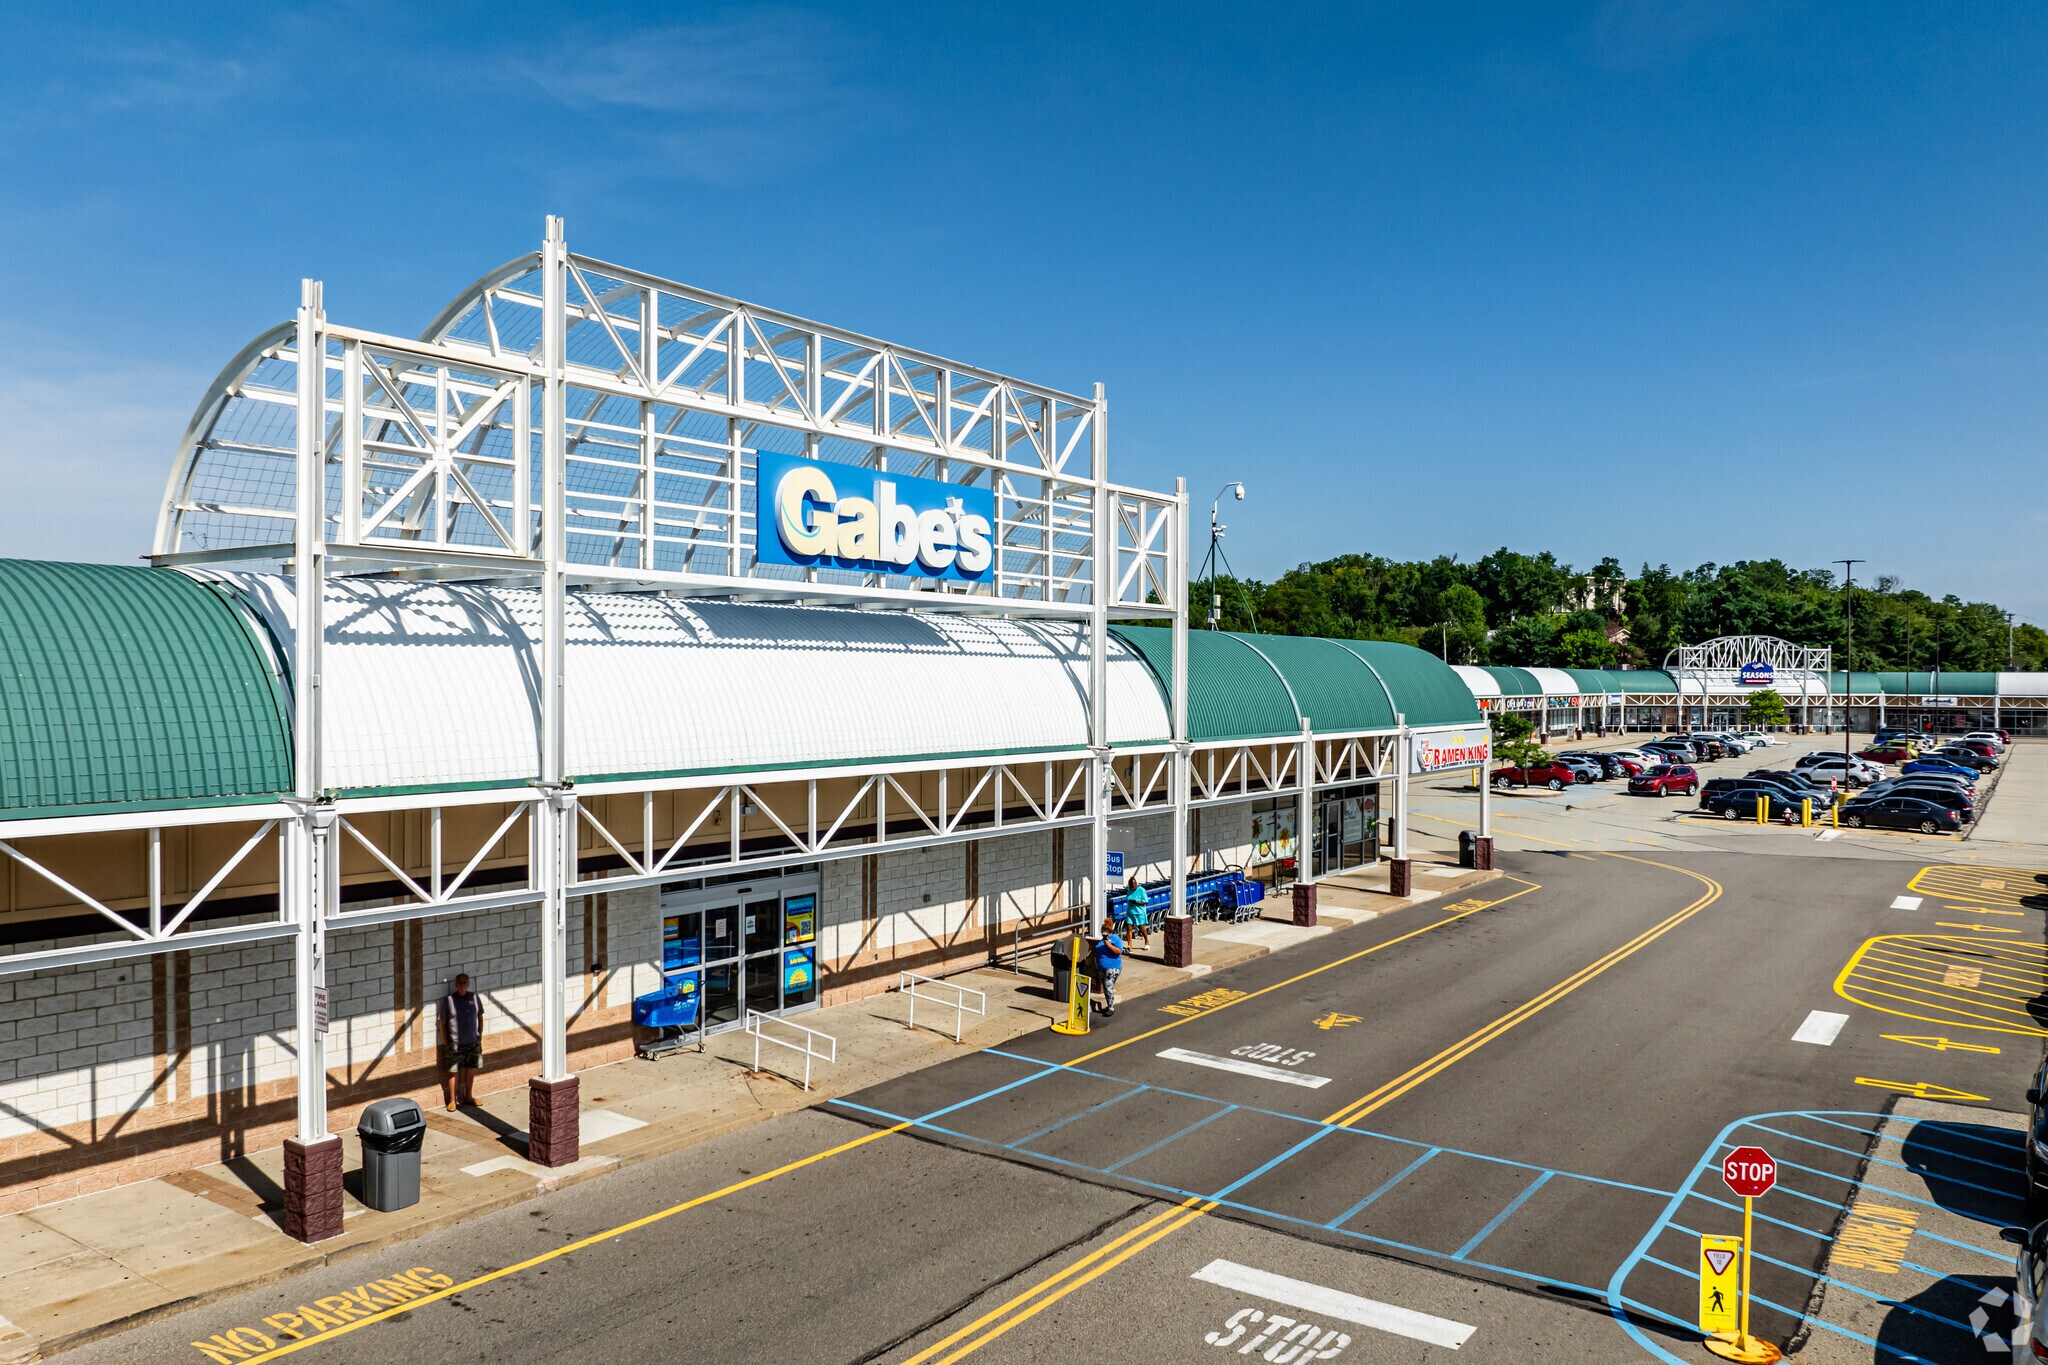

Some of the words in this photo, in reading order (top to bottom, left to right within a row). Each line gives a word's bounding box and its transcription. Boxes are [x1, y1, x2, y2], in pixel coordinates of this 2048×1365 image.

[775, 466, 992, 572] Gabe's
[1742, 671, 1773, 679] SEASONS
[1433, 747, 1466, 766] RAMEN
[1467, 743, 1489, 760] KING
[1106, 854, 1120, 863] Bus
[1230, 1042, 1317, 1066] STOP
[1726, 1161, 1774, 1182] STOP
[1713, 1252, 1726, 1260] YIELD
[190, 1327, 277, 1365] NO
[262, 1267, 454, 1339] PARKING
[1204, 1308, 1352, 1365] STOP
